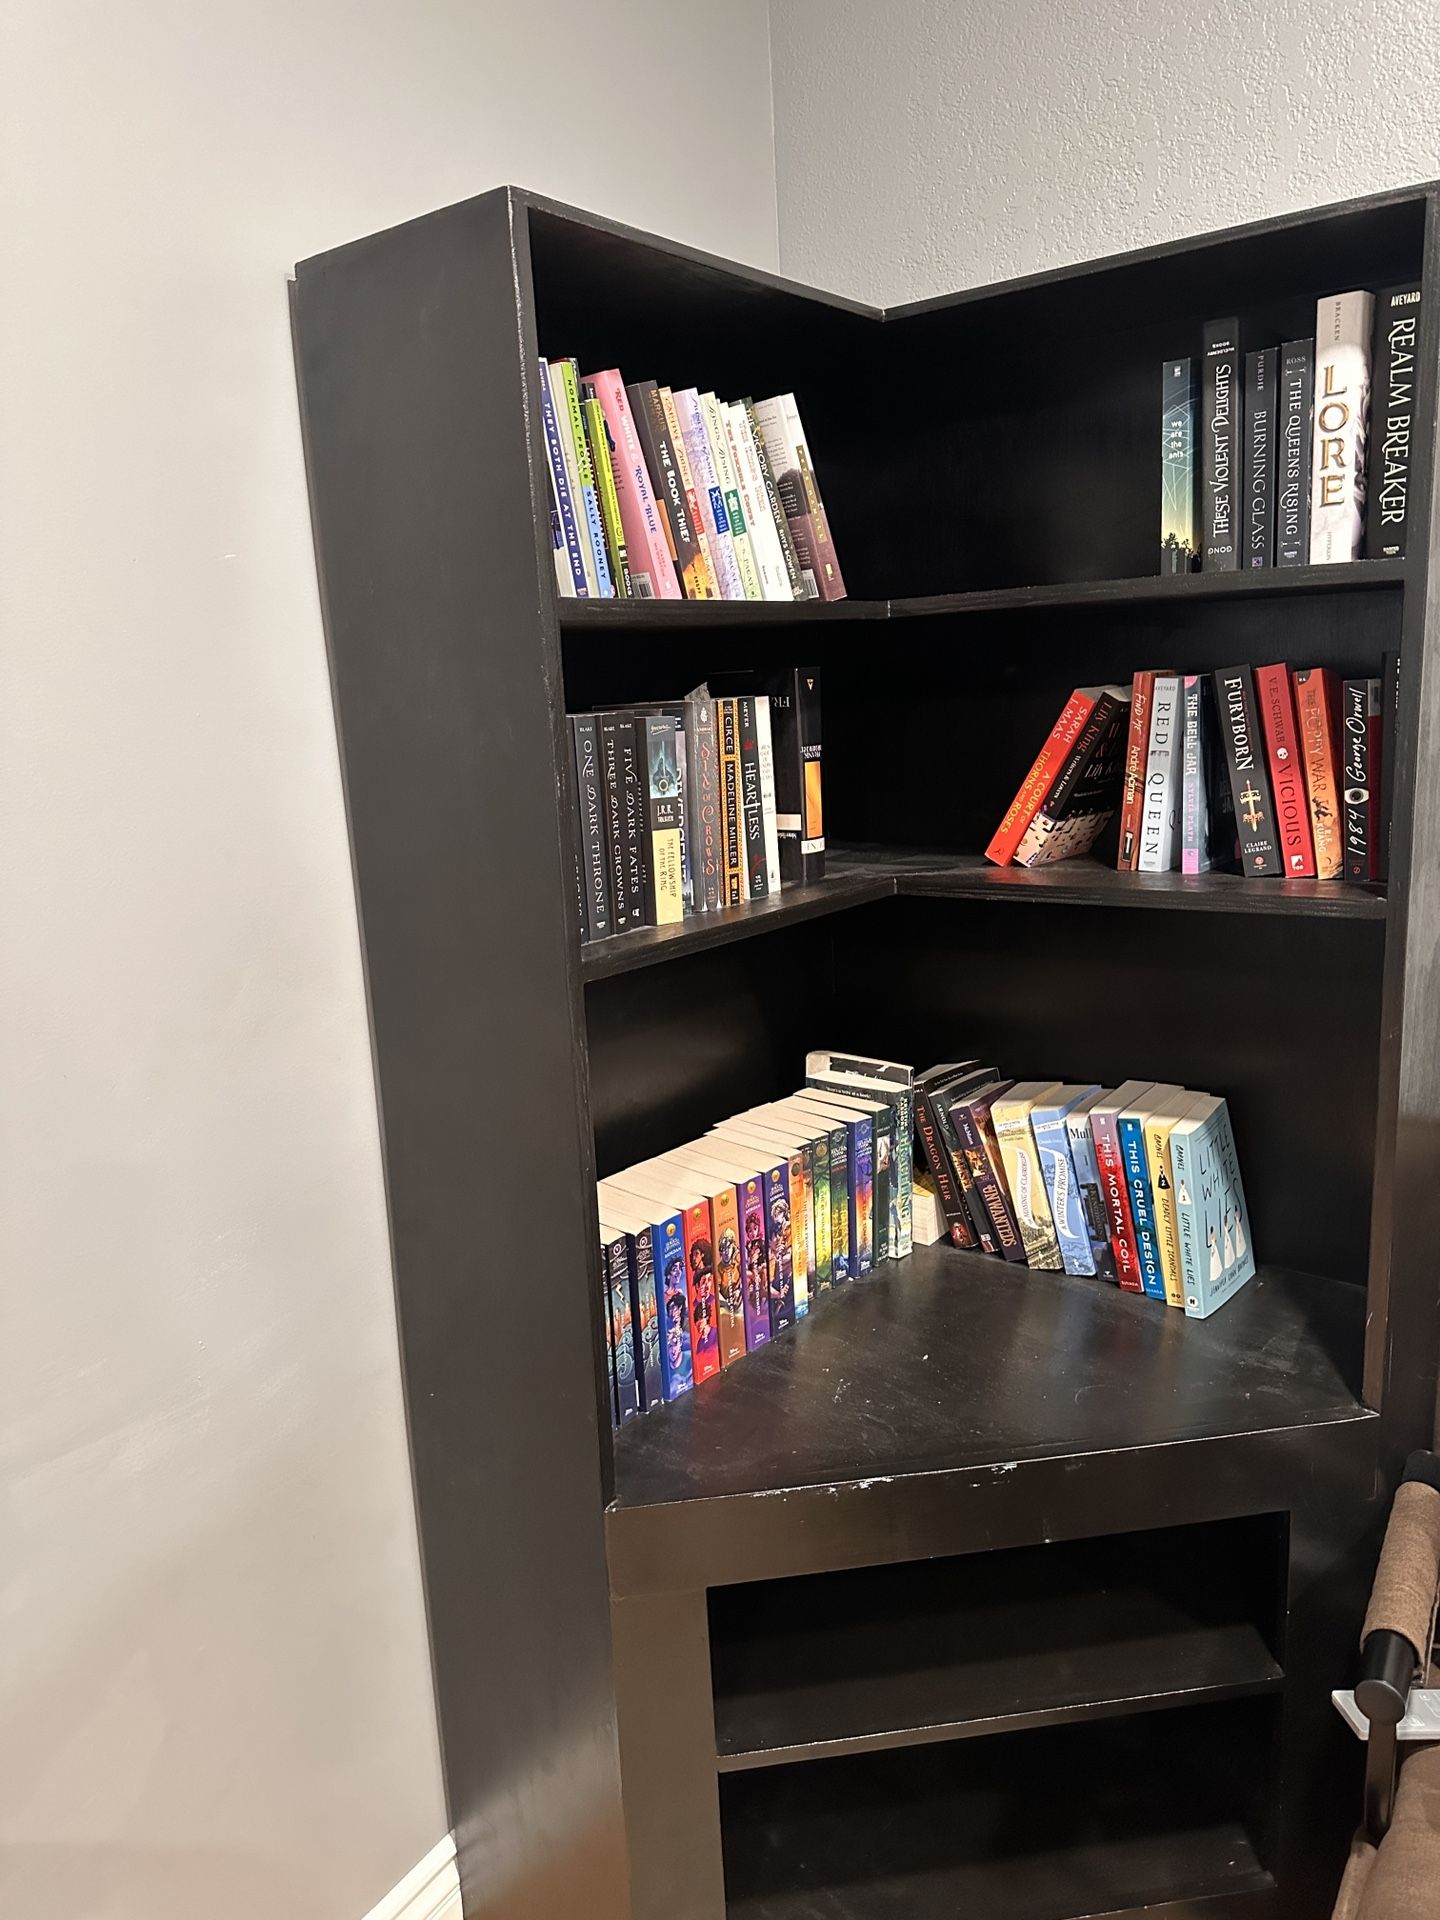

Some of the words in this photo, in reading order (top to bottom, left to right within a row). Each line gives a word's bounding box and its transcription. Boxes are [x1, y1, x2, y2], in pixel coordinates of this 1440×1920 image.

[1390, 291, 1421, 308] AVEYARD
[1257, 354, 1265, 391] PURDIE
[1286, 356, 1307, 365] ROSS
[1387, 316, 1416, 408] REALM
[650, 389, 668, 432] MARKUS
[1210, 363, 1232, 433] DELIGHTS
[1289, 378, 1302, 412] THE
[568, 379, 579, 429] NORMAL
[577, 436, 588, 479] PEOPLE
[664, 397, 680, 440] CAPTIVE
[1170, 430, 1183, 438] are
[1171, 420, 1183, 428] we
[1318, 364, 1350, 509] LORE
[615, 388, 625, 412] RED
[622, 415, 634, 450] WHITE
[634, 465, 649, 502] ROYAL
[645, 504, 657, 533] BLUE
[709, 404, 721, 441] KINGS
[718, 443, 731, 485] RISING
[1168, 450, 1184, 459] ants
[1170, 440, 1182, 449] the
[1209, 433, 1230, 493] VIOLENT
[1252, 410, 1267, 493] BURNING
[1284, 415, 1302, 479] QUEEN'S
[544, 403, 555, 432] THEY
[551, 440, 562, 471] BOTH
[559, 477, 567, 497] DIE
[563, 504, 571, 518] AT
[567, 524, 576, 546] THE
[572, 552, 581, 575] END
[659, 441, 672, 467] THE
[666, 469, 681, 506] BOOK
[677, 508, 691, 543] THIEF
[752, 425, 770, 477] VICTORY
[765, 480, 783, 524] GARDEN
[1379, 414, 1411, 526] BREAKER
[1212, 494, 1231, 539] THESE
[1251, 497, 1266, 550] GLASS
[1280, 482, 1299, 536] RISING
[586, 491, 597, 525] SALLY
[593, 532, 606, 579] ROONEY
[778, 529, 789, 550] RHYS
[784, 549, 797, 580] BOWEN
[1207, 545, 1233, 555] GONG
[742, 701, 750, 728] MEYER
[1052, 707, 1075, 740] MAAS
[1063, 706, 1088, 744] SARAH
[1134, 693, 1147, 716] FIND
[1155, 702, 1172, 745] RED
[1186, 693, 1198, 718] THE
[1224, 676, 1254, 771] FURYBORN
[1271, 698, 1285, 743] SCHWAB
[1345, 687, 1367, 734] Orwell
[725, 716, 734, 752] CIRCE
[1186, 720, 1198, 749] BELL
[582, 739, 594, 778] ONE
[607, 739, 617, 790] THREE
[623, 748, 638, 784] FIVE
[1024, 750, 1052, 790] THORNS
[1041, 771, 1052, 780] A
[1185, 752, 1197, 776] JAR
[1311, 758, 1327, 793] WAR
[1345, 736, 1367, 782] George
[586, 784, 599, 835] DARK
[626, 789, 636, 840] DARK
[726, 763, 735, 823] MADELINE
[742, 762, 761, 840] HEARTLESS
[1026, 781, 1046, 816] COURT
[1145, 772, 1165, 855] QUEEN
[1278, 764, 1302, 847] VICIOUS
[610, 794, 620, 839] DARK
[1000, 801, 1022, 834] ROSES
[1315, 821, 1327, 853] KUANG
[1347, 808, 1367, 856] 1984
[701, 804, 716, 876] CROWS
[728, 826, 737, 865] MILLER
[1244, 845, 1272, 854] LEGRAND
[1246, 840, 1268, 849] CLAIRE
[591, 841, 605, 914] THRONE
[614, 844, 625, 910] CROWNS
[629, 845, 639, 894] FATES
[659, 871, 668, 892] RING
[668, 851, 677, 898] FELLOWSHIP
[936, 1103, 950, 1130] ARNOLD
[917, 1105, 926, 1123] THE
[922, 1126, 942, 1170] DRAGON
[938, 1174, 952, 1201] HEIR
[1101, 1133, 1115, 1167] THIS
[1127, 1140, 1141, 1174] THIS
[1153, 1133, 1164, 1159] BARNES
[1175, 1144, 1185, 1171] BARNES
[1199, 1123, 1231, 1175] LITTLE
[899, 1130, 911, 1219] GRACELING
[1057, 1158, 1067, 1190] PROMISE
[1201, 1151, 1236, 1201] WHITE
[982, 1184, 1017, 1247] UNWANTEDS
[1107, 1173, 1125, 1234] MORTAL
[1133, 1179, 1148, 1226] CRUEL
[1161, 1198, 1170, 1225] DEADLY
[1205, 1177, 1243, 1249] LIES
[1164, 1226, 1174, 1248] LITTLE
[1181, 1212, 1191, 1239] LITTLE
[1118, 1238, 1131, 1273] COIL
[1141, 1231, 1156, 1286] DESIGN
[1167, 1249, 1177, 1281] SCANDALS
[1183, 1240, 1193, 1266] WHITE
[1186, 1268, 1195, 1286] LIES
